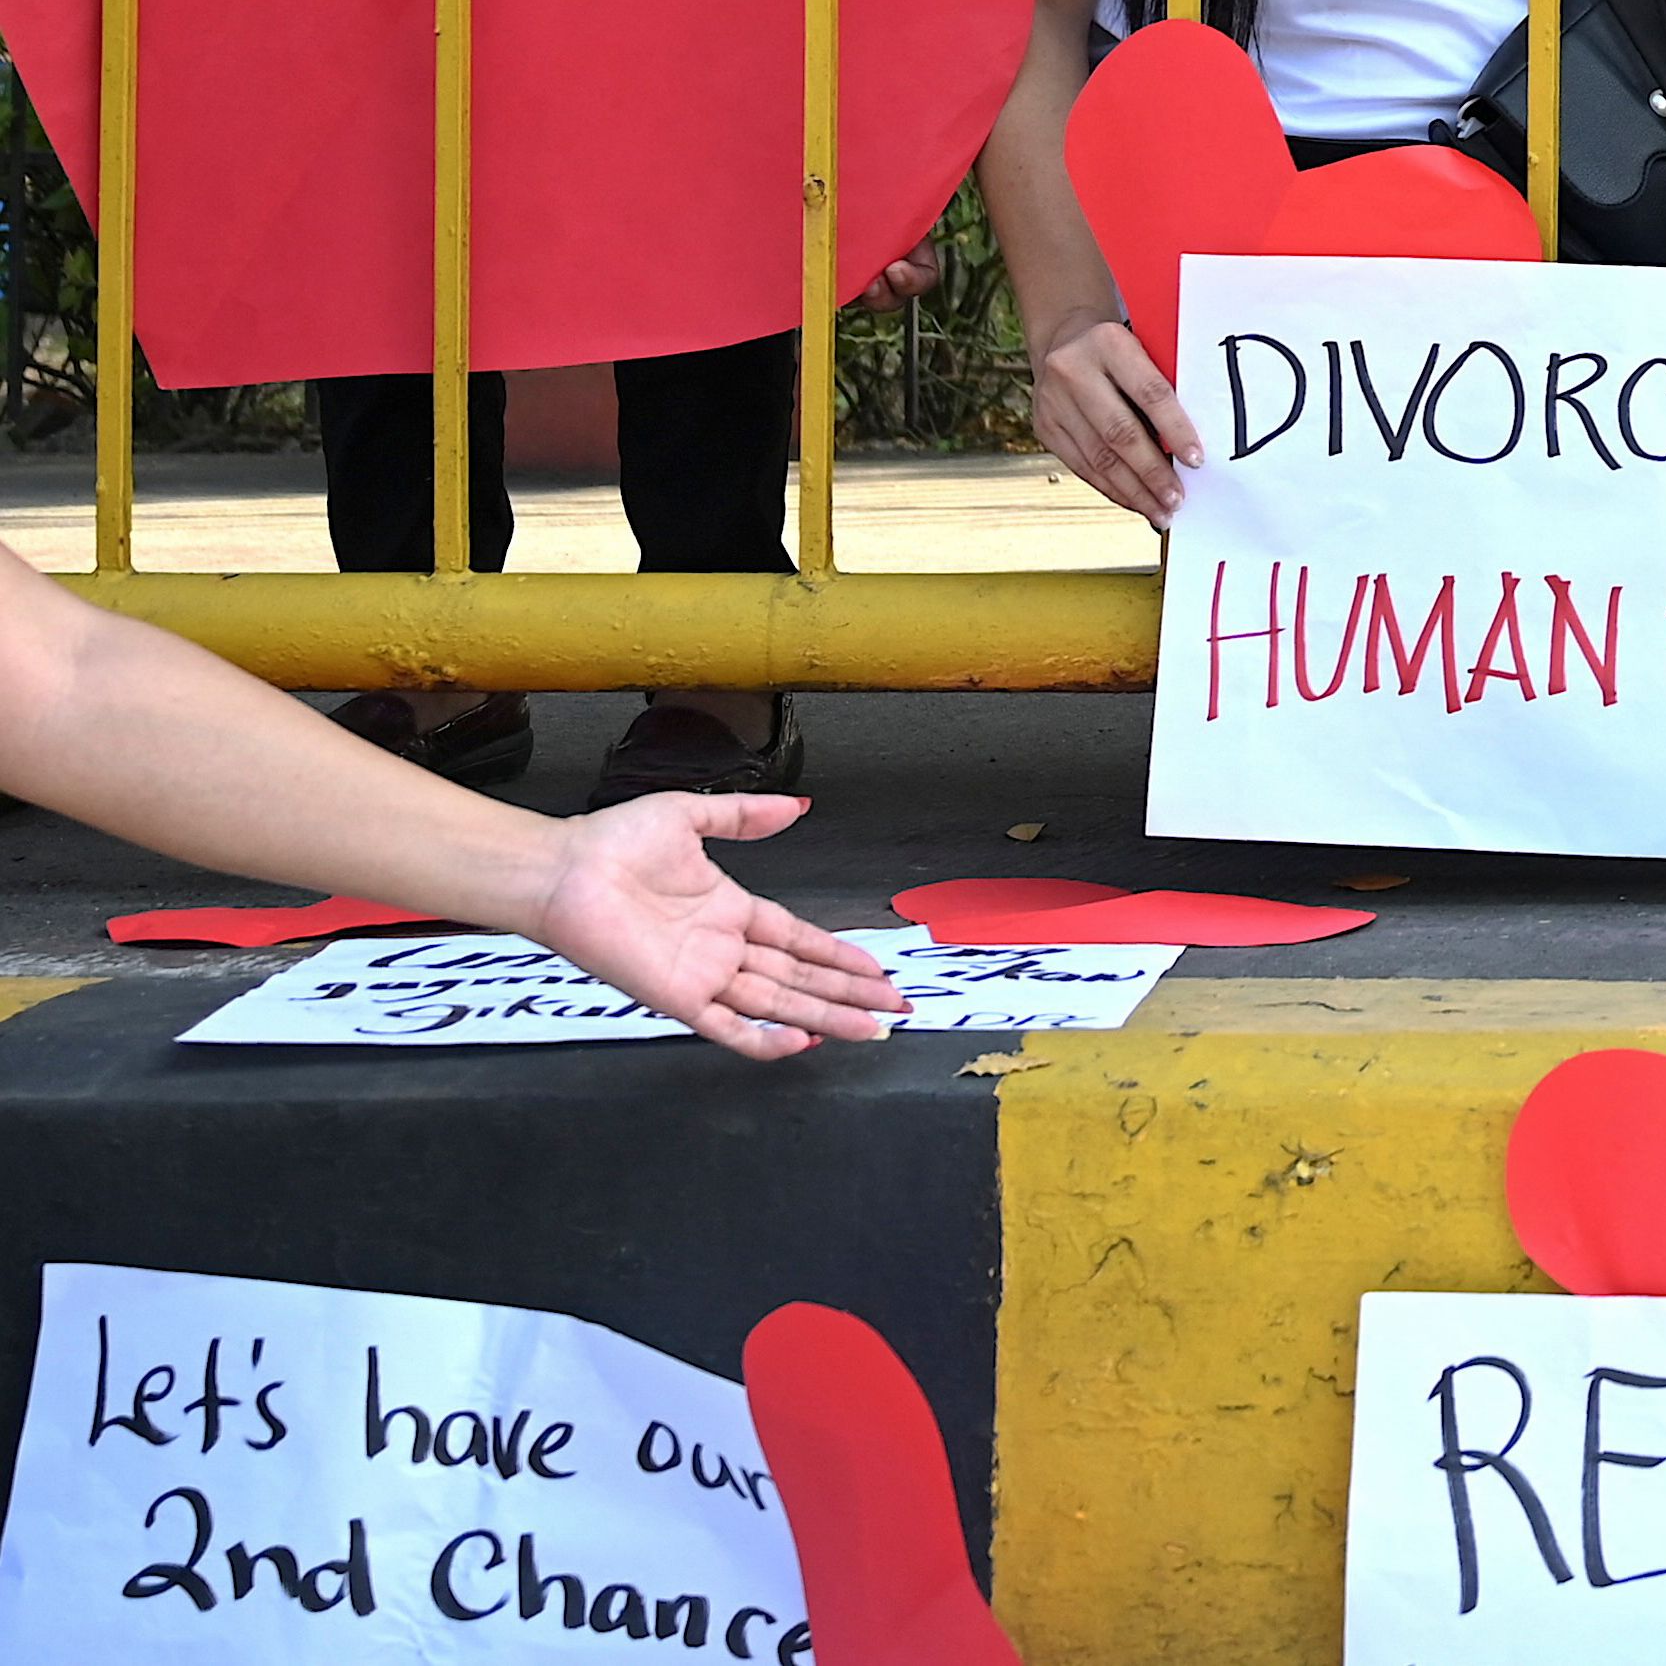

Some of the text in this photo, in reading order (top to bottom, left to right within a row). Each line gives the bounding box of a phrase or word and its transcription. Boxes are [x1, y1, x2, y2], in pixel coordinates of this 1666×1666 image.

[1206, 560, 1622, 722] HUMAN
[87, 1315, 289, 1455] Let's
[366, 1345, 578, 1481] have
[122, 1486, 376, 1614] 2nd
